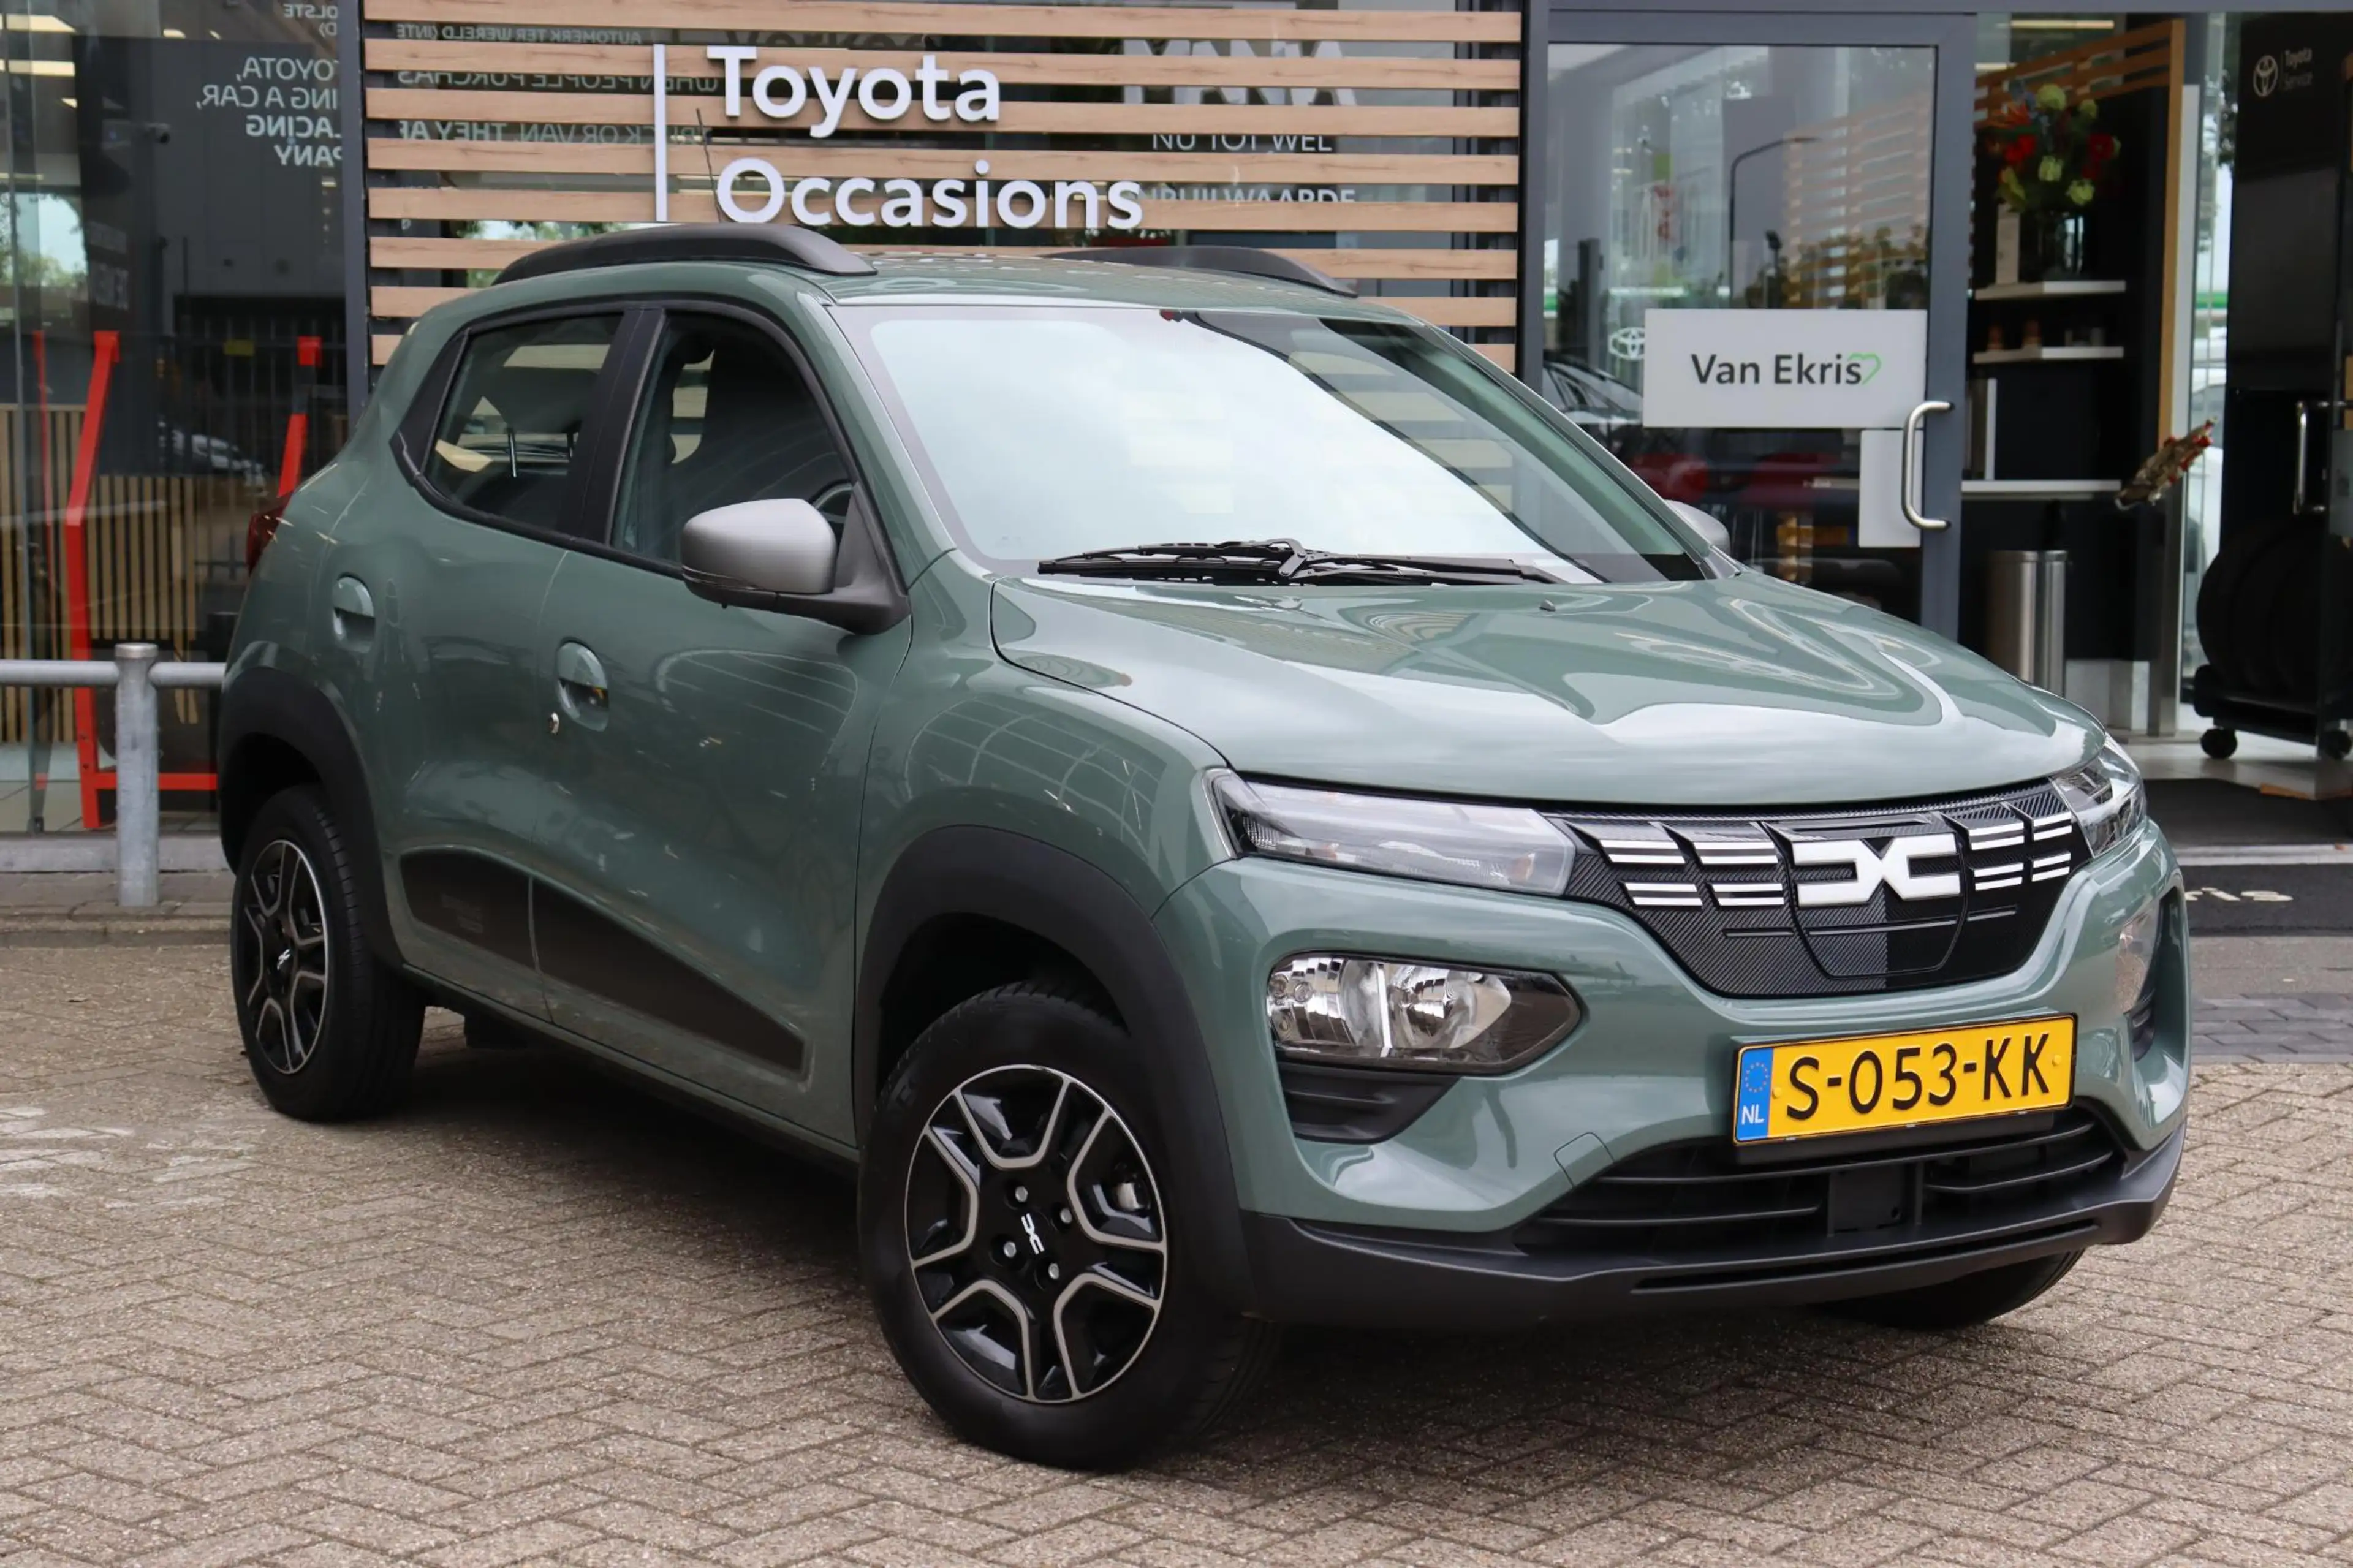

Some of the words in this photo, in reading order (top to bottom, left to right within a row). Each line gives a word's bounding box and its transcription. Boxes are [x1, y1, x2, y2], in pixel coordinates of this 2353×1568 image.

[707, 45, 1000, 138] Toyota
[1152, 134, 1196, 150] NU
[1271, 134, 1333, 151] WEL
[717, 158, 1142, 229] Occasions
[1691, 354, 1760, 385] Van
[1774, 353, 1862, 385] Ekris
[1786, 1033, 2050, 1121] S-053-KK
[1741, 1105, 1765, 1126] NL
